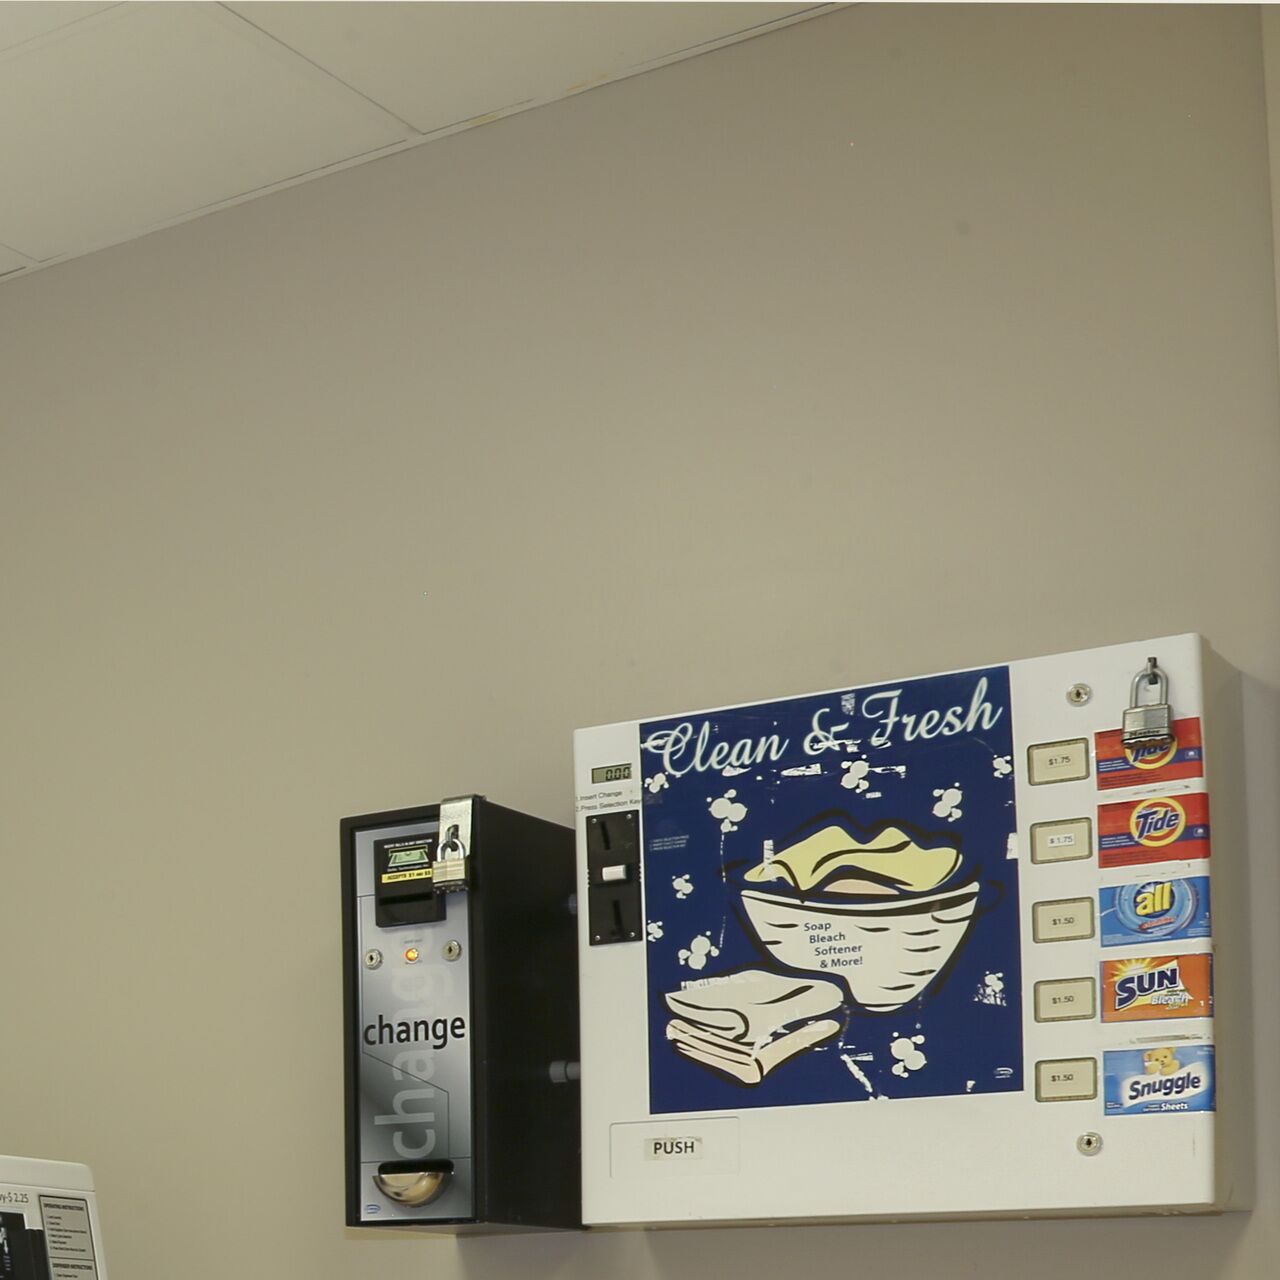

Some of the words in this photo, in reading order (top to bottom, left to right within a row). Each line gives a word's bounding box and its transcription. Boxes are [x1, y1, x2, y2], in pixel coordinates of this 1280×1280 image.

[646, 721, 789, 777] Clean
[803, 708, 850, 755] &
[862, 677, 1003, 746] Fresh
[1048, 756, 1071, 766] $1.75
[1135, 808, 1180, 841] Tide
[1136, 882, 1172, 916] all
[804, 922, 831, 932] Soap
[1052, 917, 1075, 926] $1.50
[809, 932, 846, 944] Bleach
[814, 945, 862, 956] Softener
[820, 960, 828, 968] &
[831, 956, 863, 967] More!
[1114, 968, 1178, 1010] SUN
[1052, 996, 1075, 1004] $1.50
[364, 1015, 466, 1050] change
[1051, 1074, 1074, 1082] $1.50
[1128, 1072, 1201, 1101] Snuggle
[1161, 1103, 1188, 1111] Sheets
[654, 1141, 694, 1154] PUSH
